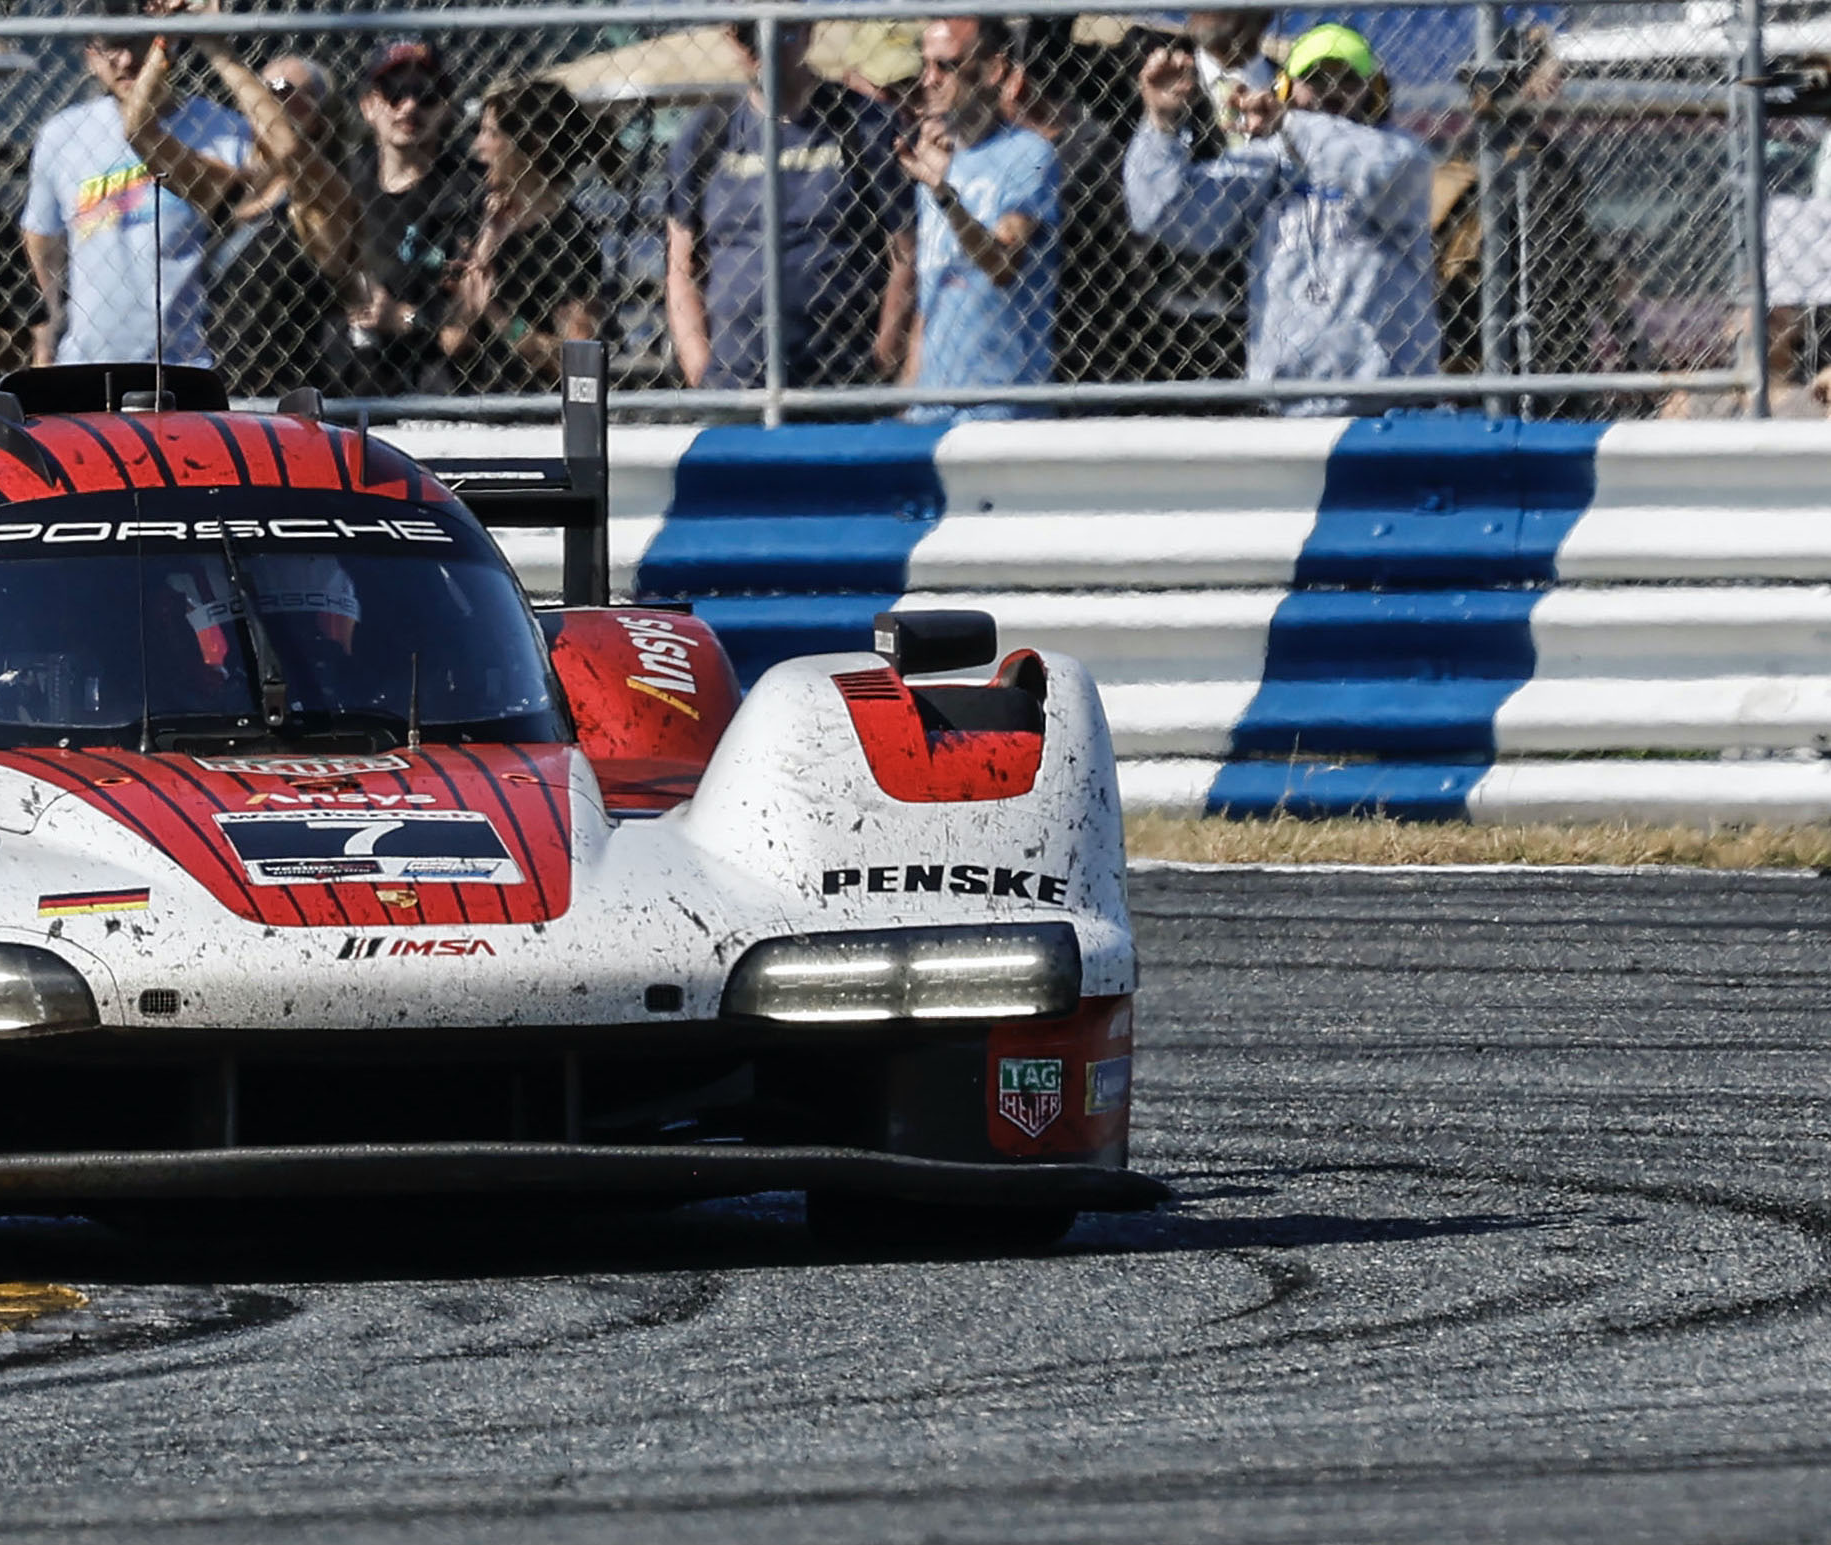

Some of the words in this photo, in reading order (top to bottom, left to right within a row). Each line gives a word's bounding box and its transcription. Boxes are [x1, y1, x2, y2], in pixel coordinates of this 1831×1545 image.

[616, 616, 700, 721] Ansys
[246, 793, 437, 806] Ansys
[228, 809, 483, 822] WeatherTech
[307, 821, 405, 856] 7
[822, 865, 1069, 906] PENSKE
[389, 939, 498, 957] IMSA
[1006, 1063, 1057, 1088] TAG
